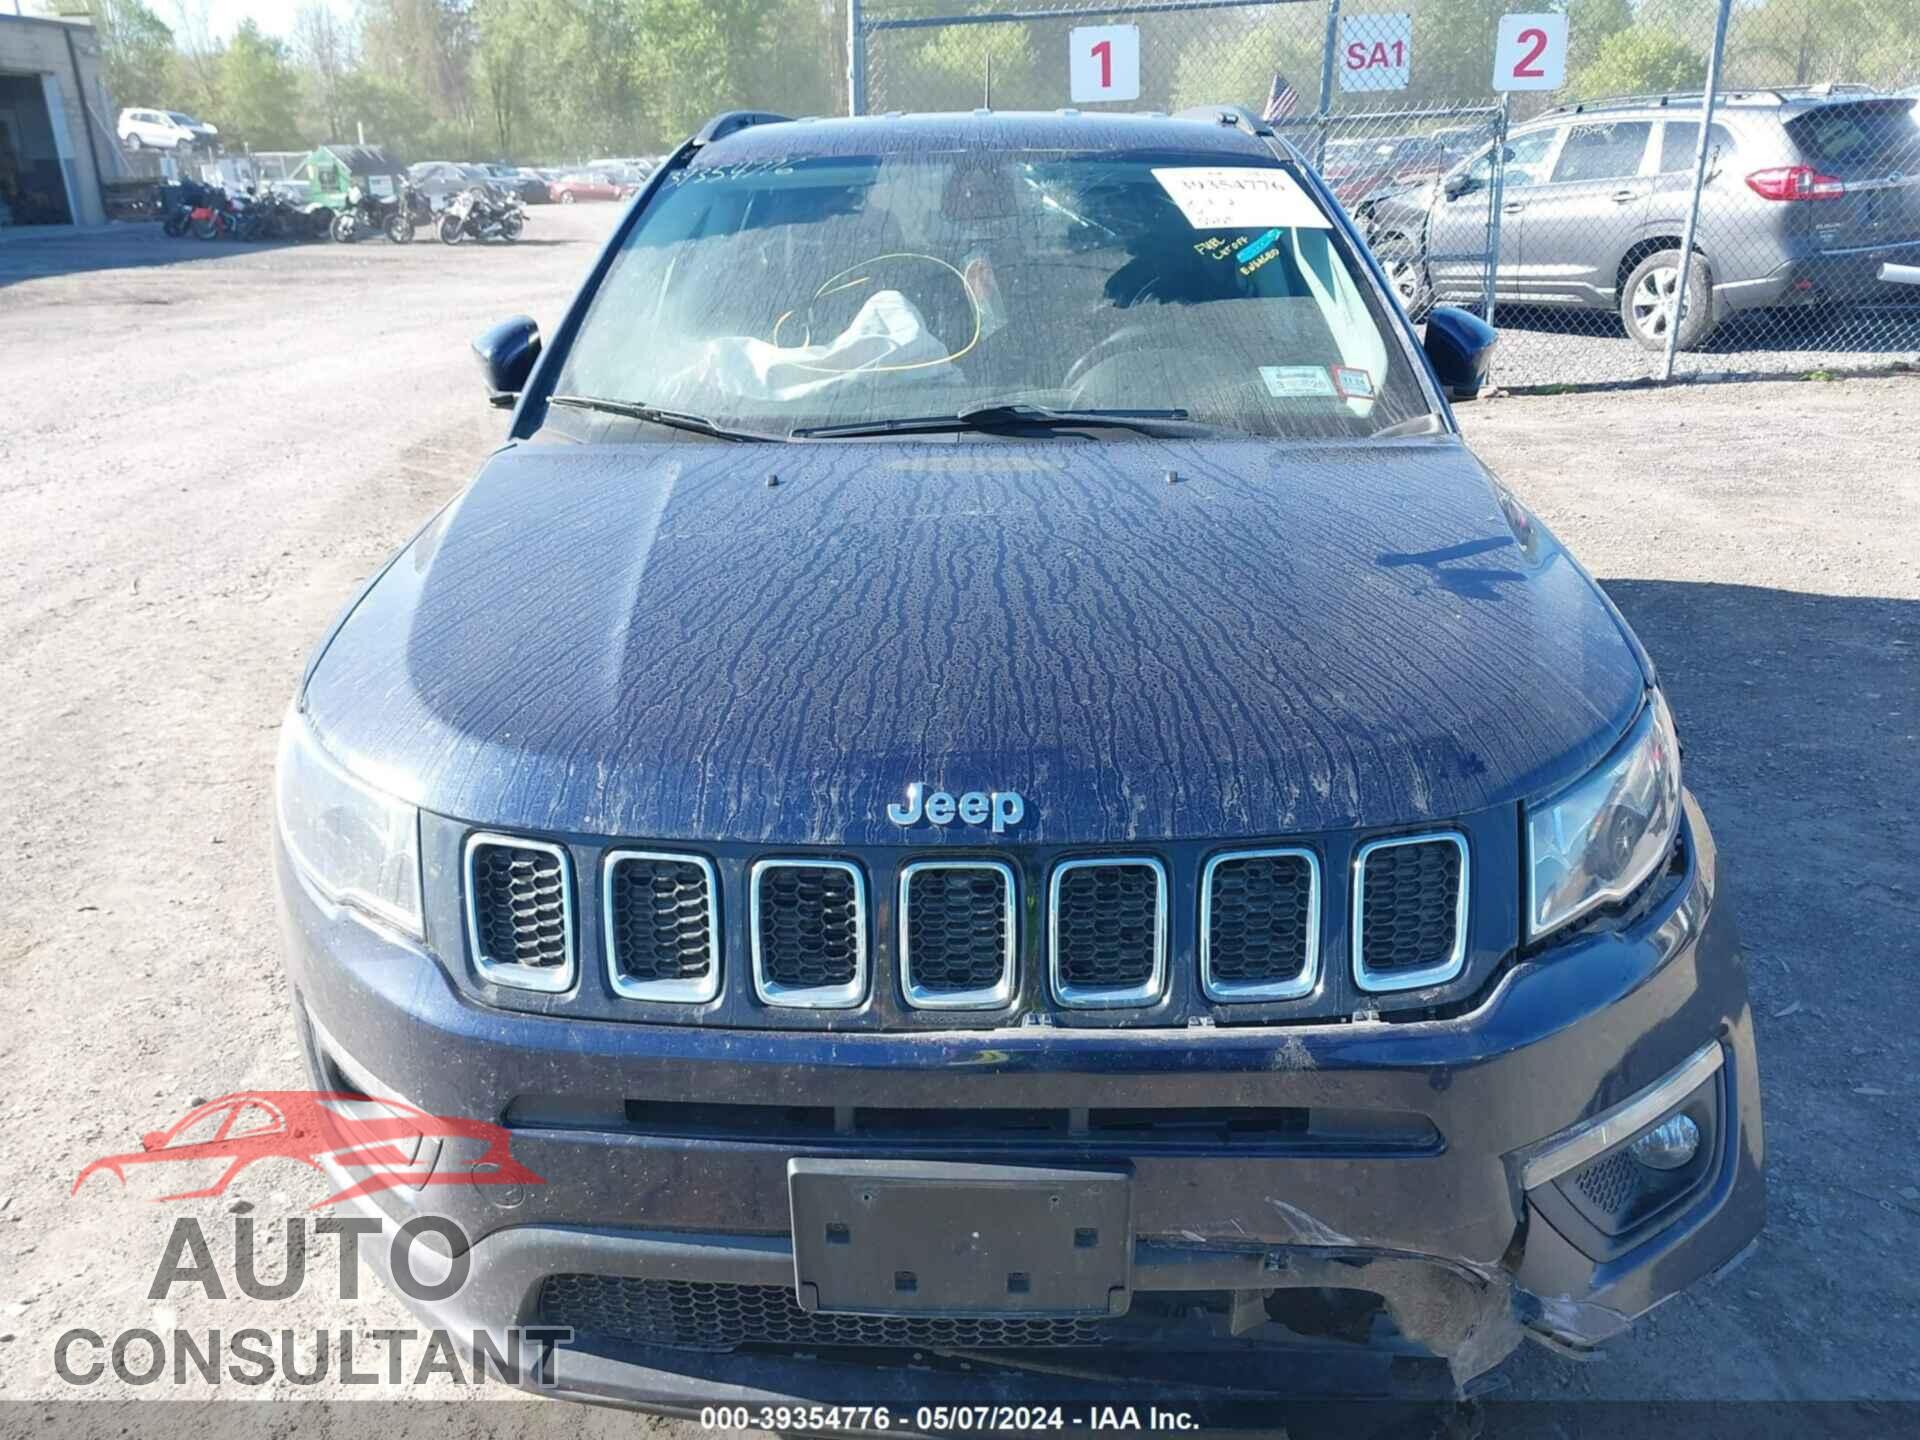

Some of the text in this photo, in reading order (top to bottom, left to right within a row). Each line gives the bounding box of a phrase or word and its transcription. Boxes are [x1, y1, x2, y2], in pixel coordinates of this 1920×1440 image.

[1090, 40, 1112, 88] 1
[1346, 39, 1405, 70] SA1
[1513, 28, 1549, 78] 2
[887, 782, 1025, 833] Jeep
